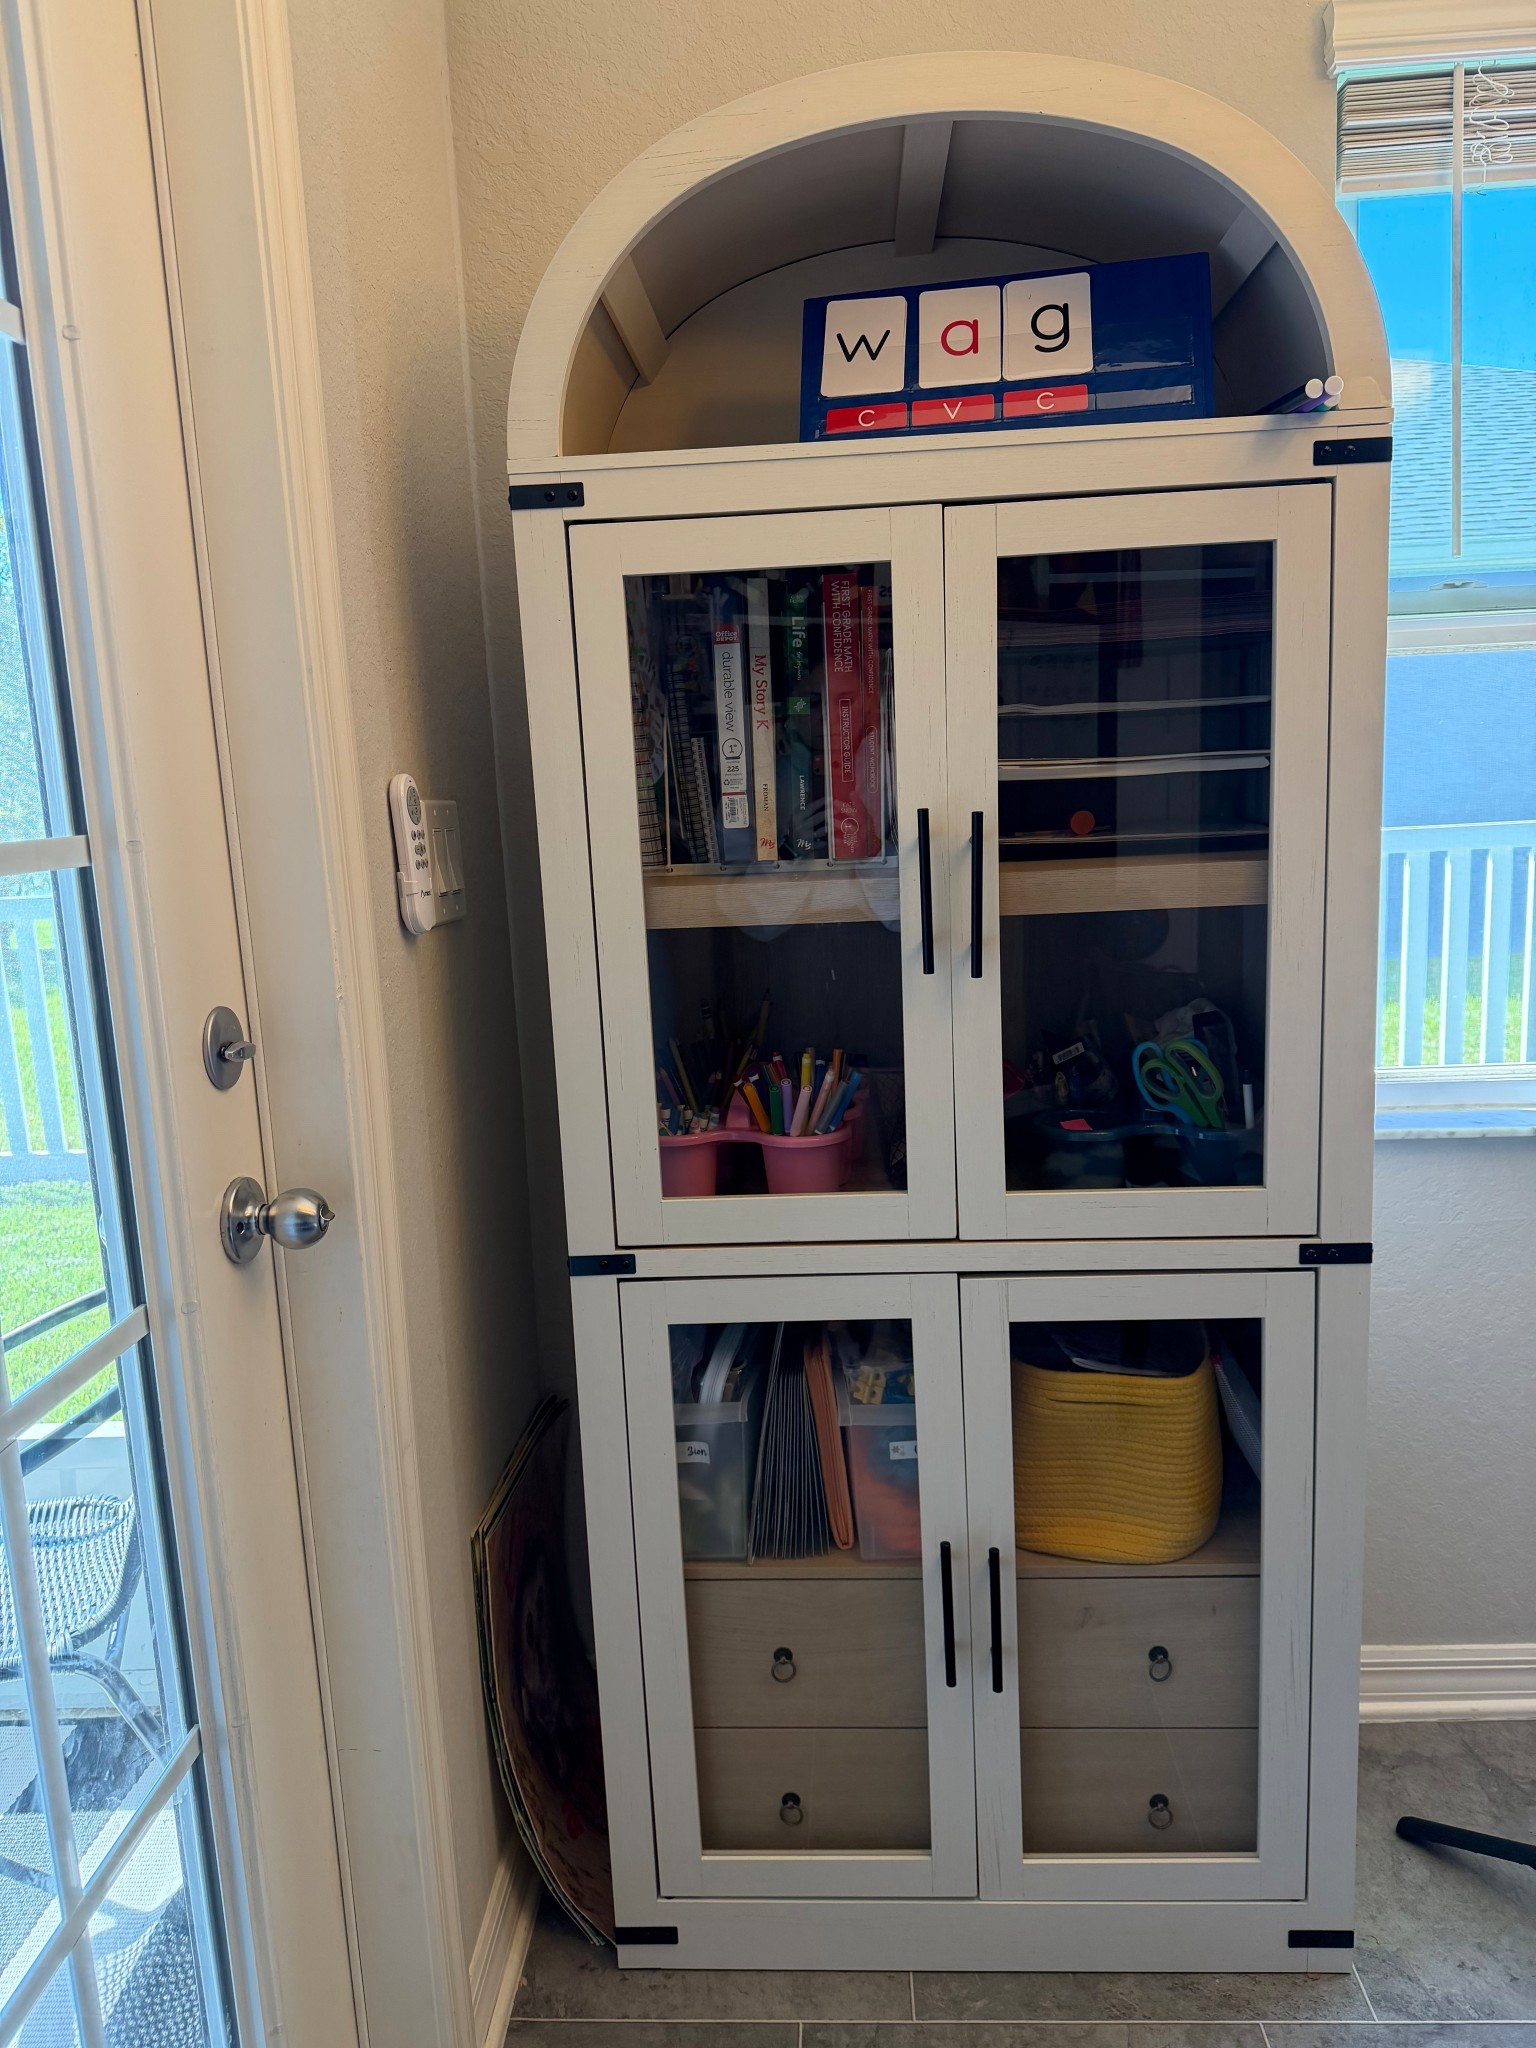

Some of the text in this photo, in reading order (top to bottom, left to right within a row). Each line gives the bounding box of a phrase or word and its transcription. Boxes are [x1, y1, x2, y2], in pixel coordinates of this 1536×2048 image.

[715, 630, 738, 638] Office
[791, 616, 806, 648] Life
[832, 580, 843, 672] WITH CONFIDENCE
[842, 580, 853, 672] FIRST GRADE MATH
[721, 651, 736, 732] durable view
[753, 655, 769, 730] My Story K
[841, 706, 851, 774] INSTRUCTOR GUIDE
